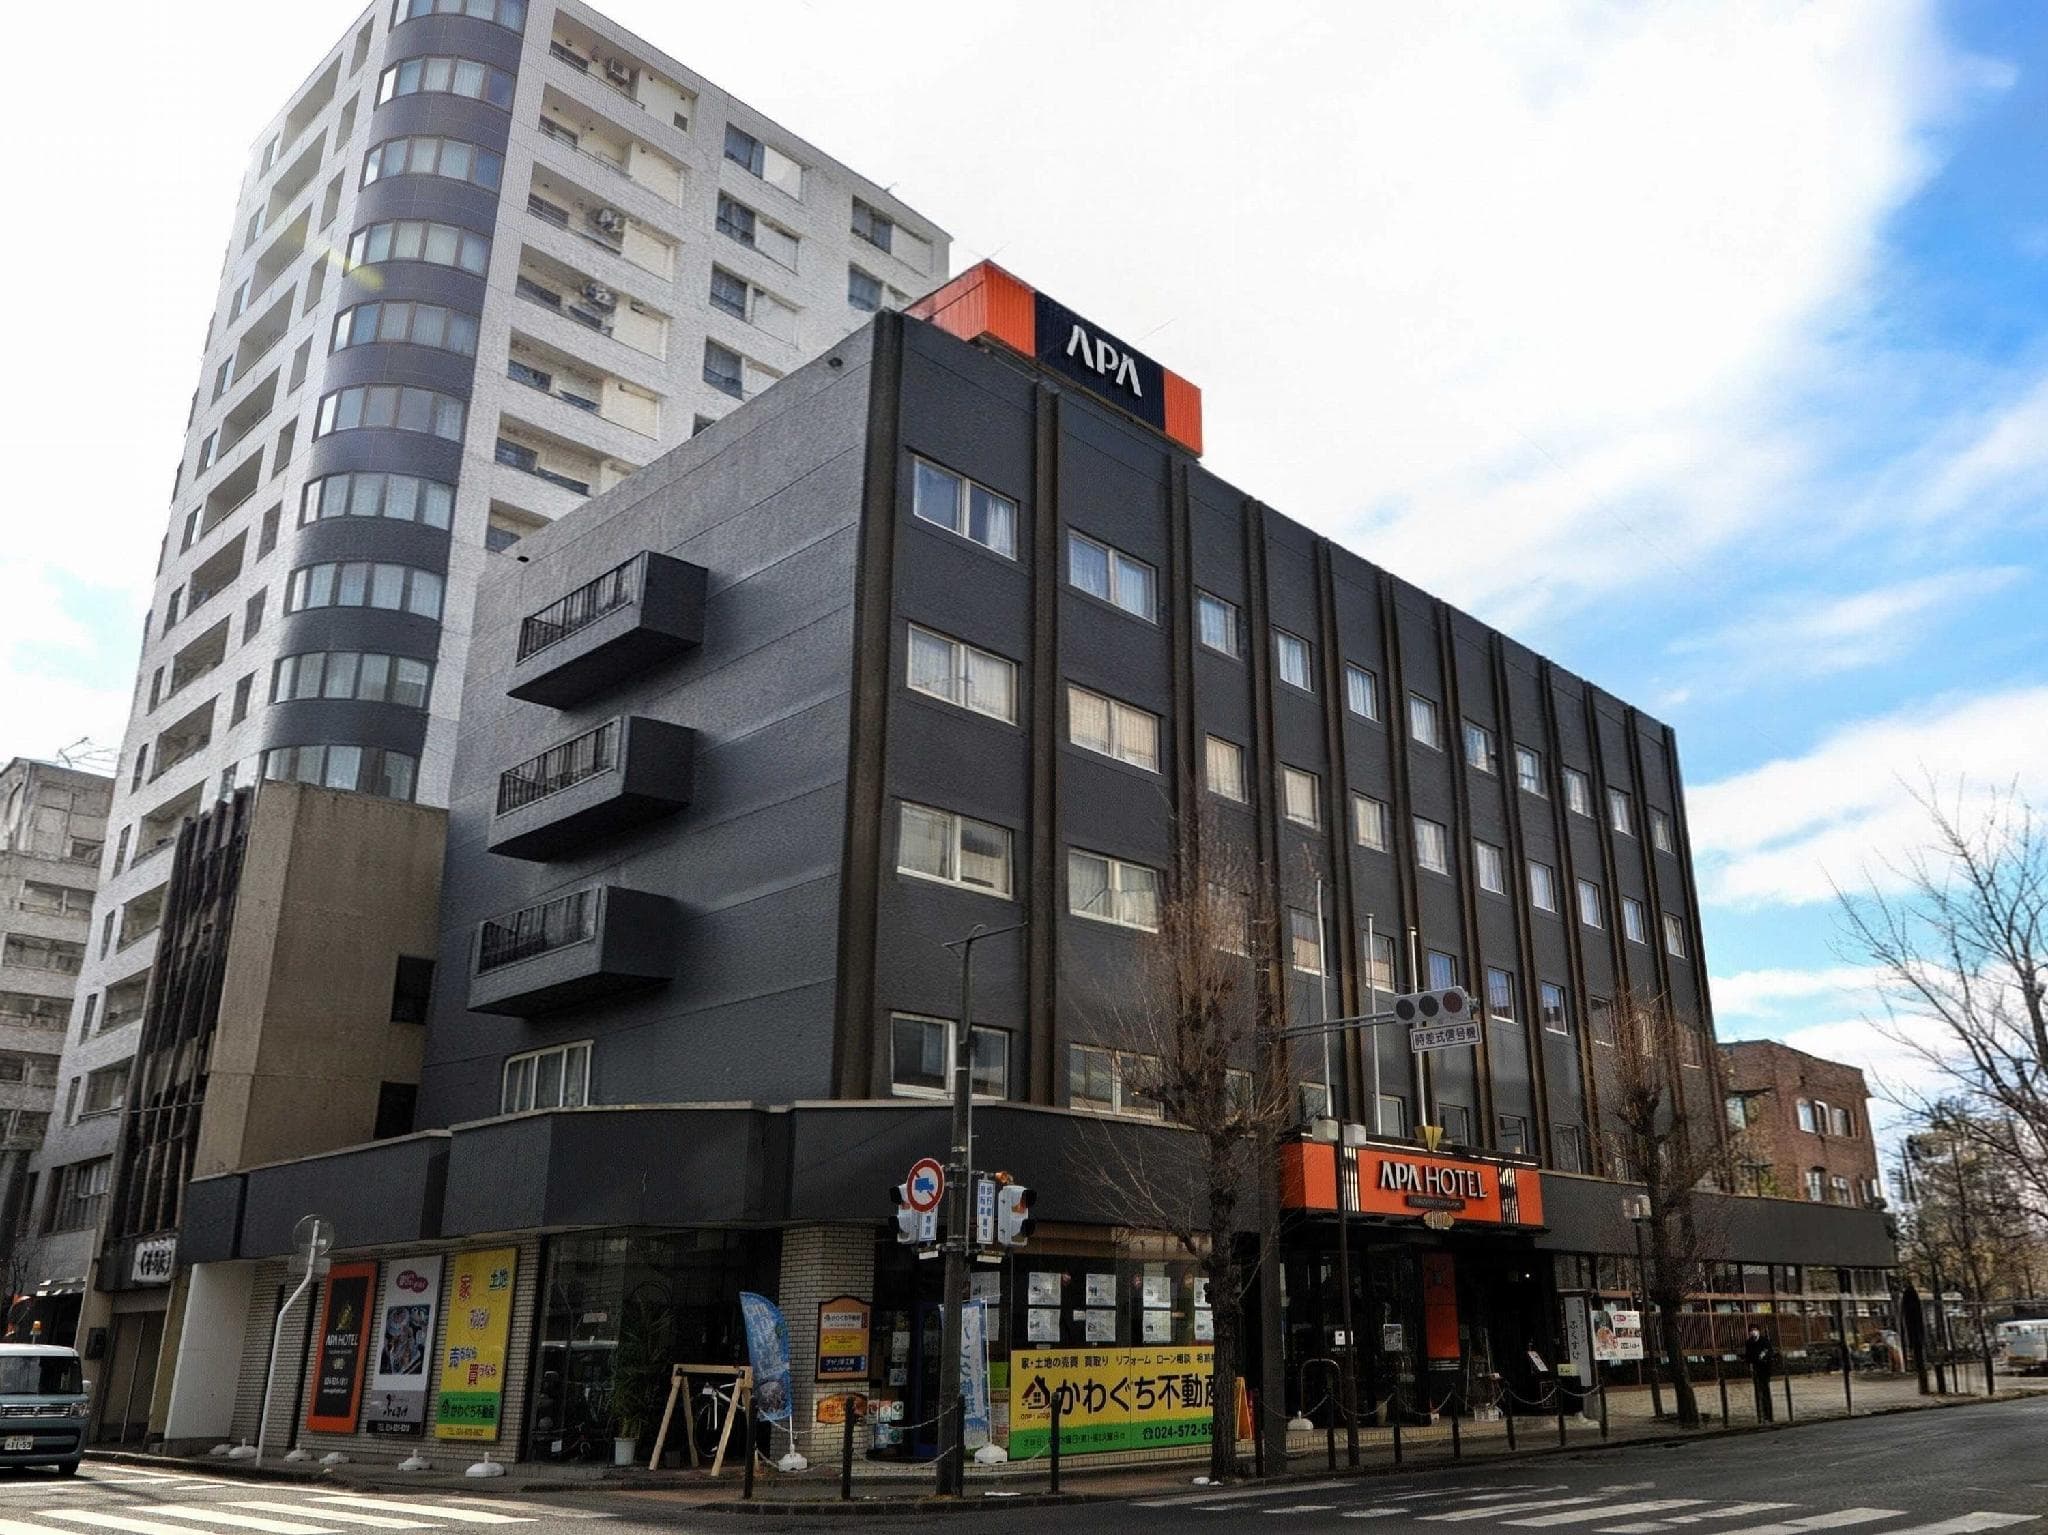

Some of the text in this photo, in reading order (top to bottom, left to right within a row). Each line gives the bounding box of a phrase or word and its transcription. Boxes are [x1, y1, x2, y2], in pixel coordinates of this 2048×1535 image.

[1066, 324, 1143, 397] APA
[1414, 1026, 1477, 1046] 時差式信号機
[1381, 1160, 1488, 1198] APA HOTEL
